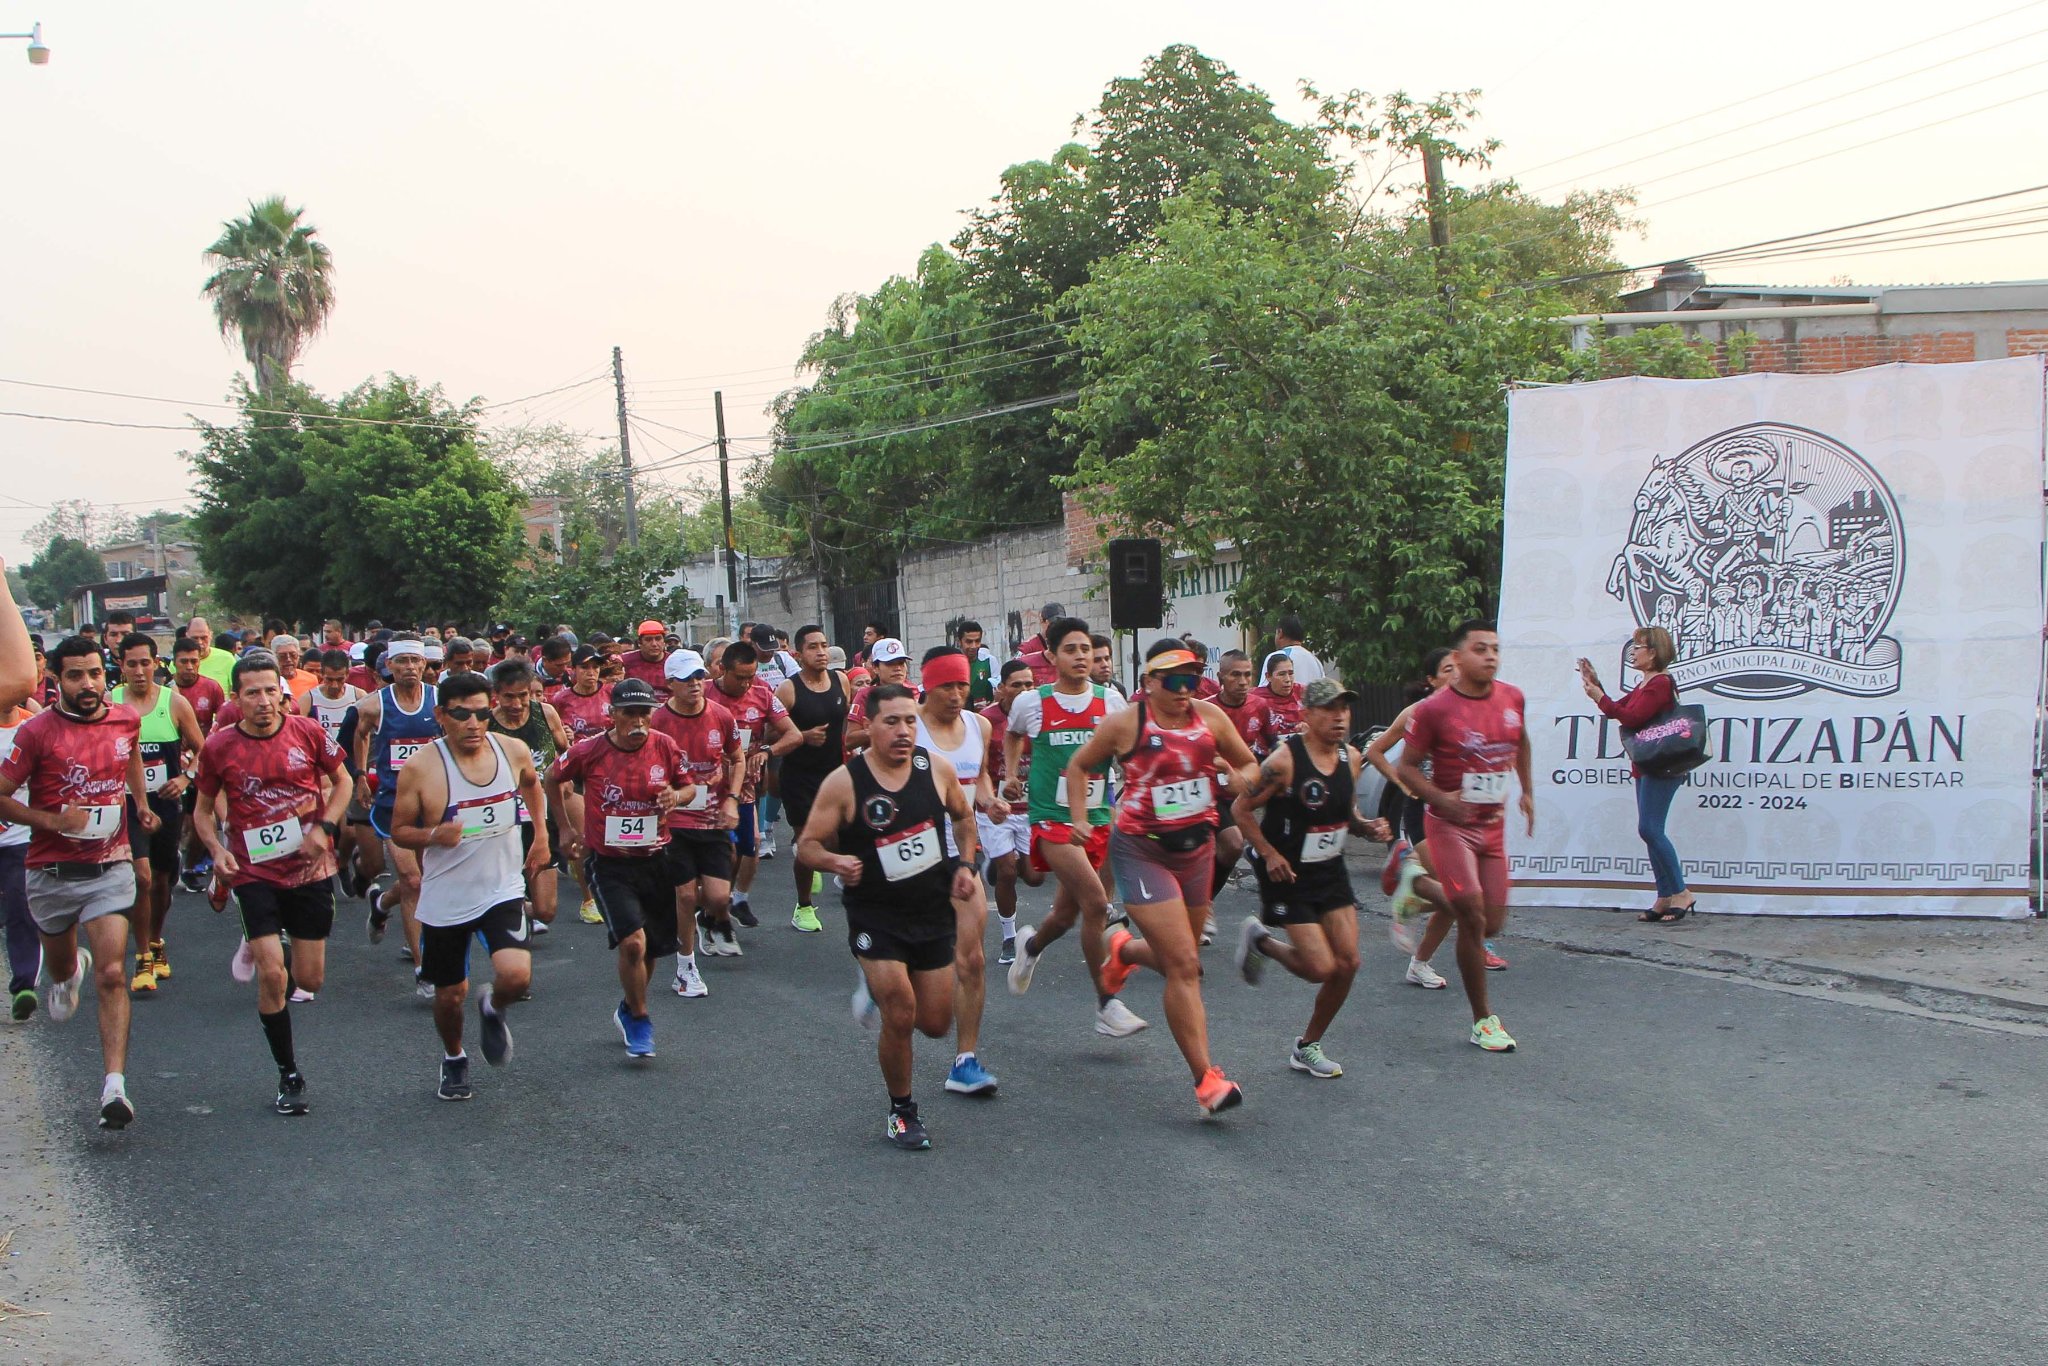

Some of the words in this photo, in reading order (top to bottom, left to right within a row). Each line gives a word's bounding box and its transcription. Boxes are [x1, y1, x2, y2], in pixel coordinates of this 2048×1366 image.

[1710, 655, 1788, 672] MUNICIPAL
[1792, 658, 1808, 672] DE
[1811, 663, 1889, 686] BIENESTAR
[1049, 731, 1094, 746] MEXIC
[1555, 709, 1966, 764] TLTIZAPÁN
[1552, 769, 1632, 785] GOBIER
[1803, 774, 1832, 788] DE
[1839, 771, 1964, 789] BIENESTAR
[1163, 781, 1202, 804] 214
[1698, 795, 1742, 808] 2022
[1760, 796, 1807, 809] 2024
[482, 807, 495, 823] 3
[259, 825, 287, 846] 62
[620, 818, 645, 834] 54
[899, 837, 924, 861] 65
